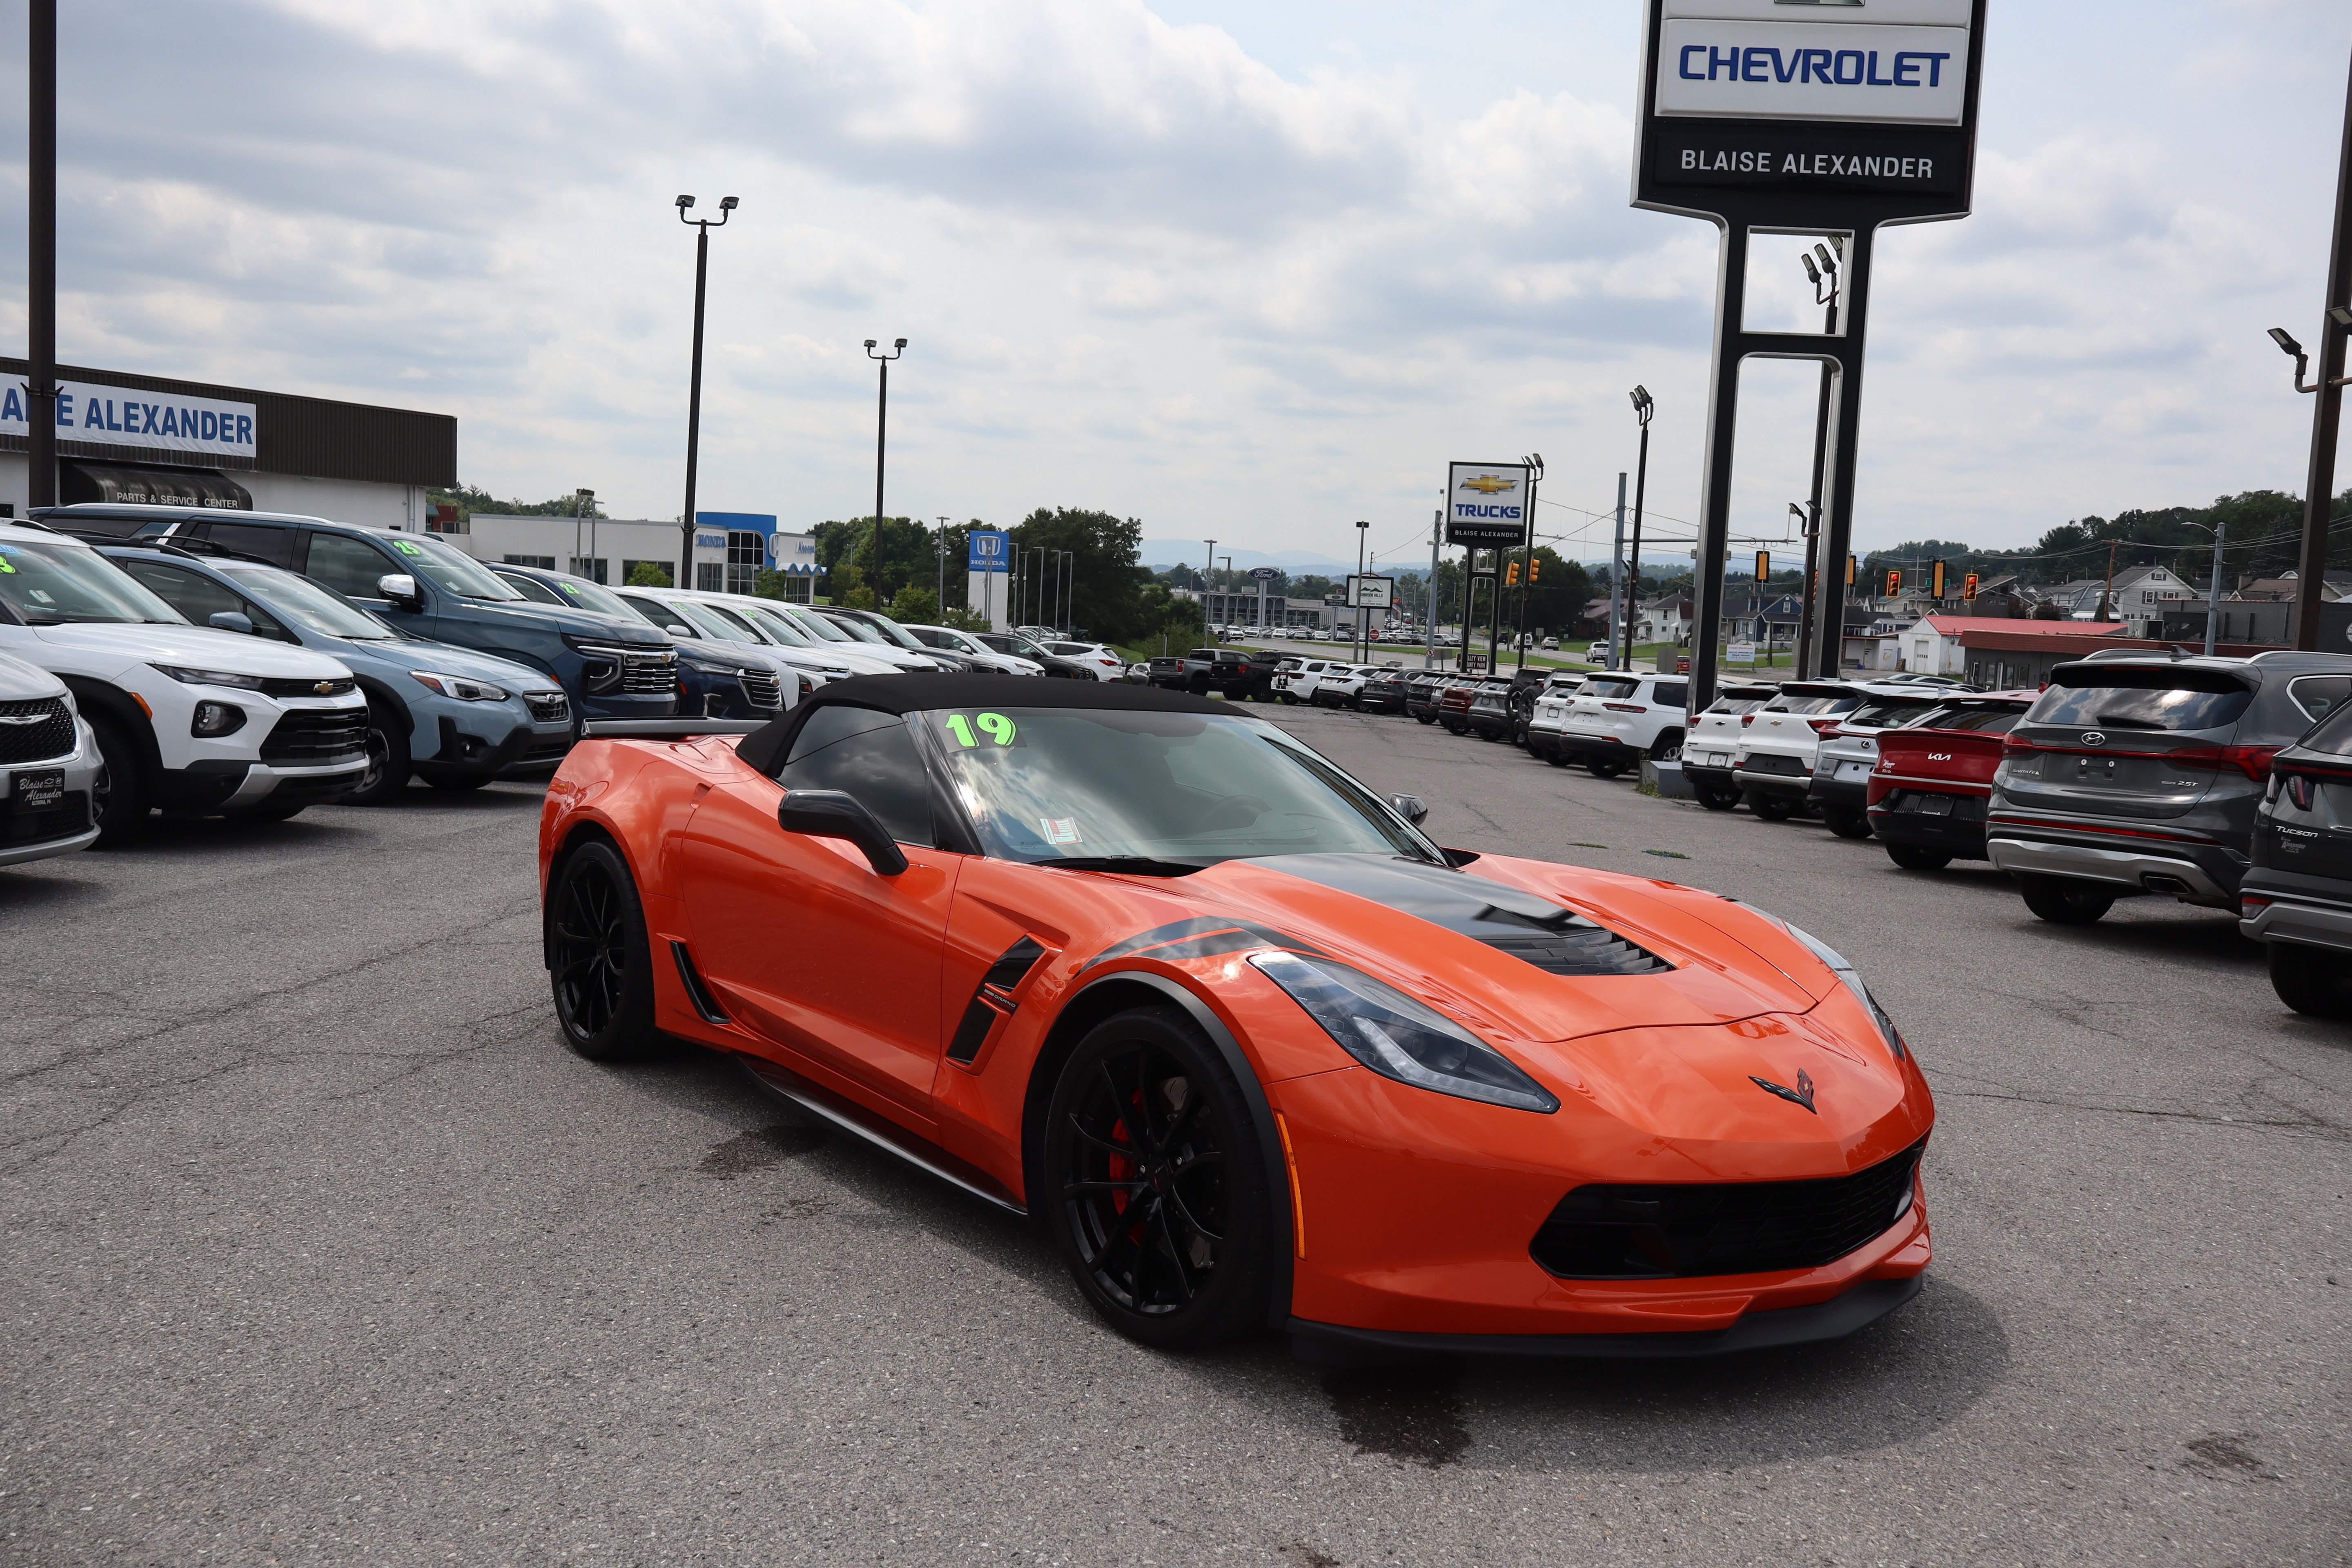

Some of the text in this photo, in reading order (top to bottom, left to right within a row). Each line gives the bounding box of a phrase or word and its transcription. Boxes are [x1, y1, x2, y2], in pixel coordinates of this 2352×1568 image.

[1679, 45, 1950, 87] CHEVROLET
[1681, 149, 1933, 178] BLAISE ALEXANDER
[84, 397, 253, 445] ALEXANDER
[116, 492, 238, 508] PARTS & SERVICE CENTER
[1455, 504, 1520, 519] TRUCKS
[394, 541, 420, 555] 25
[697, 534, 726, 548] HONDA
[1254, 569, 1274, 578] Ford
[559, 583, 581, 595] 23
[945, 713, 1016, 747] 19
[19, 778, 44, 790] Blaise
[24, 788, 62, 802] Alexander
[994, 994, 1016, 1008] GRAND
